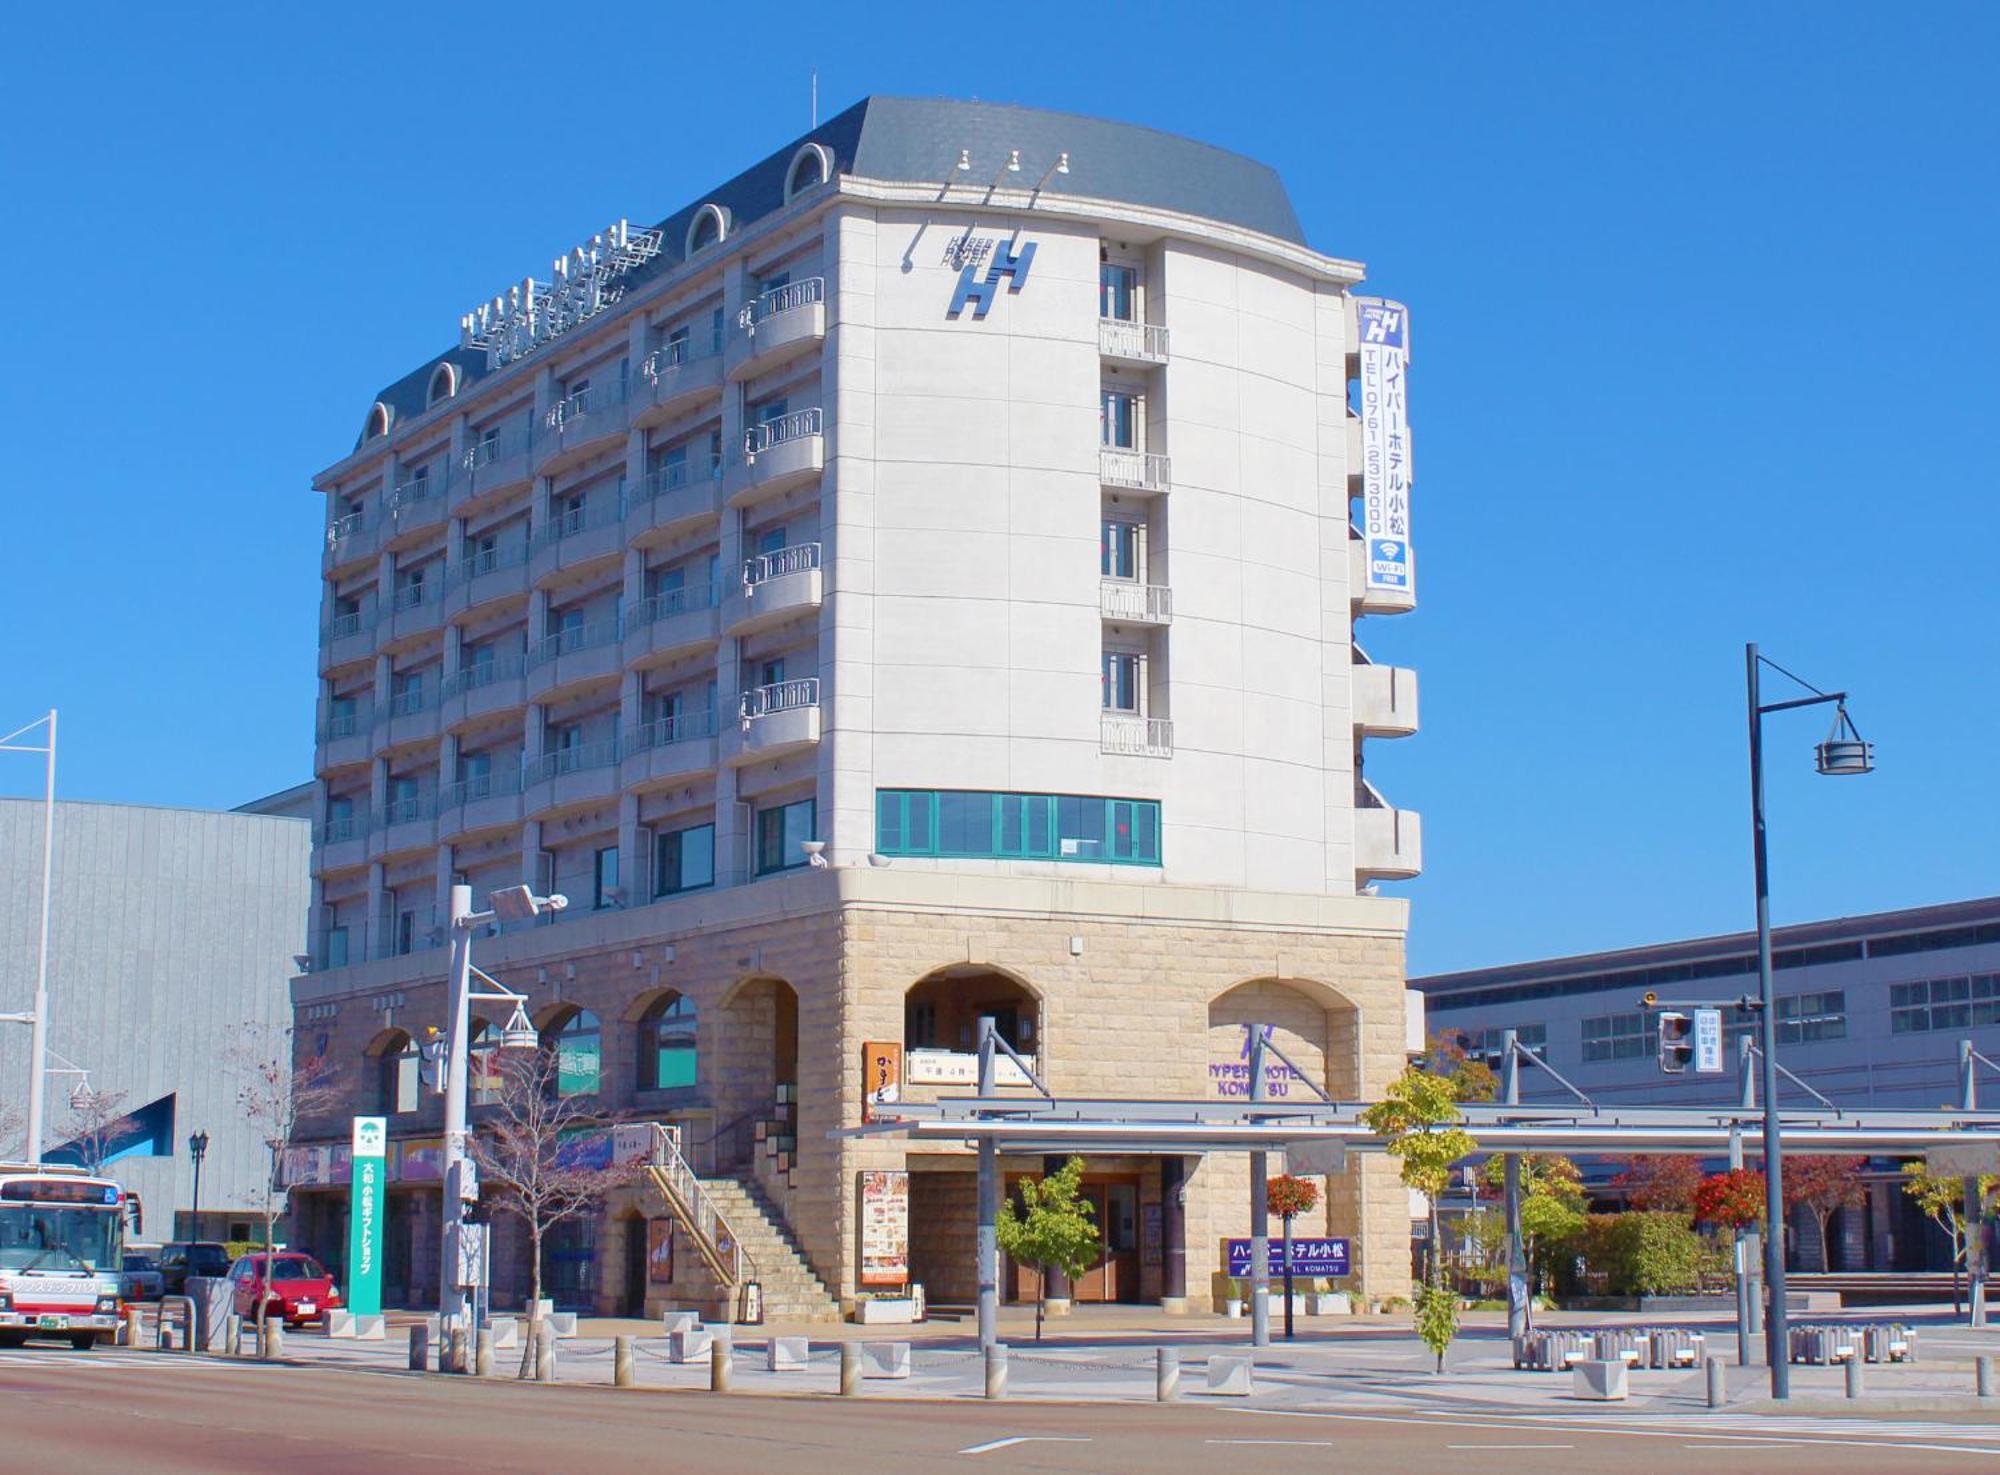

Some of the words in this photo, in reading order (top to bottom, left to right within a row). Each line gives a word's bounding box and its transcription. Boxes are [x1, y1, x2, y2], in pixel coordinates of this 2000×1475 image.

[1218, 1081, 1288, 1096] KOMSU
[1233, 1243, 1344, 1258] ハーテル小松
